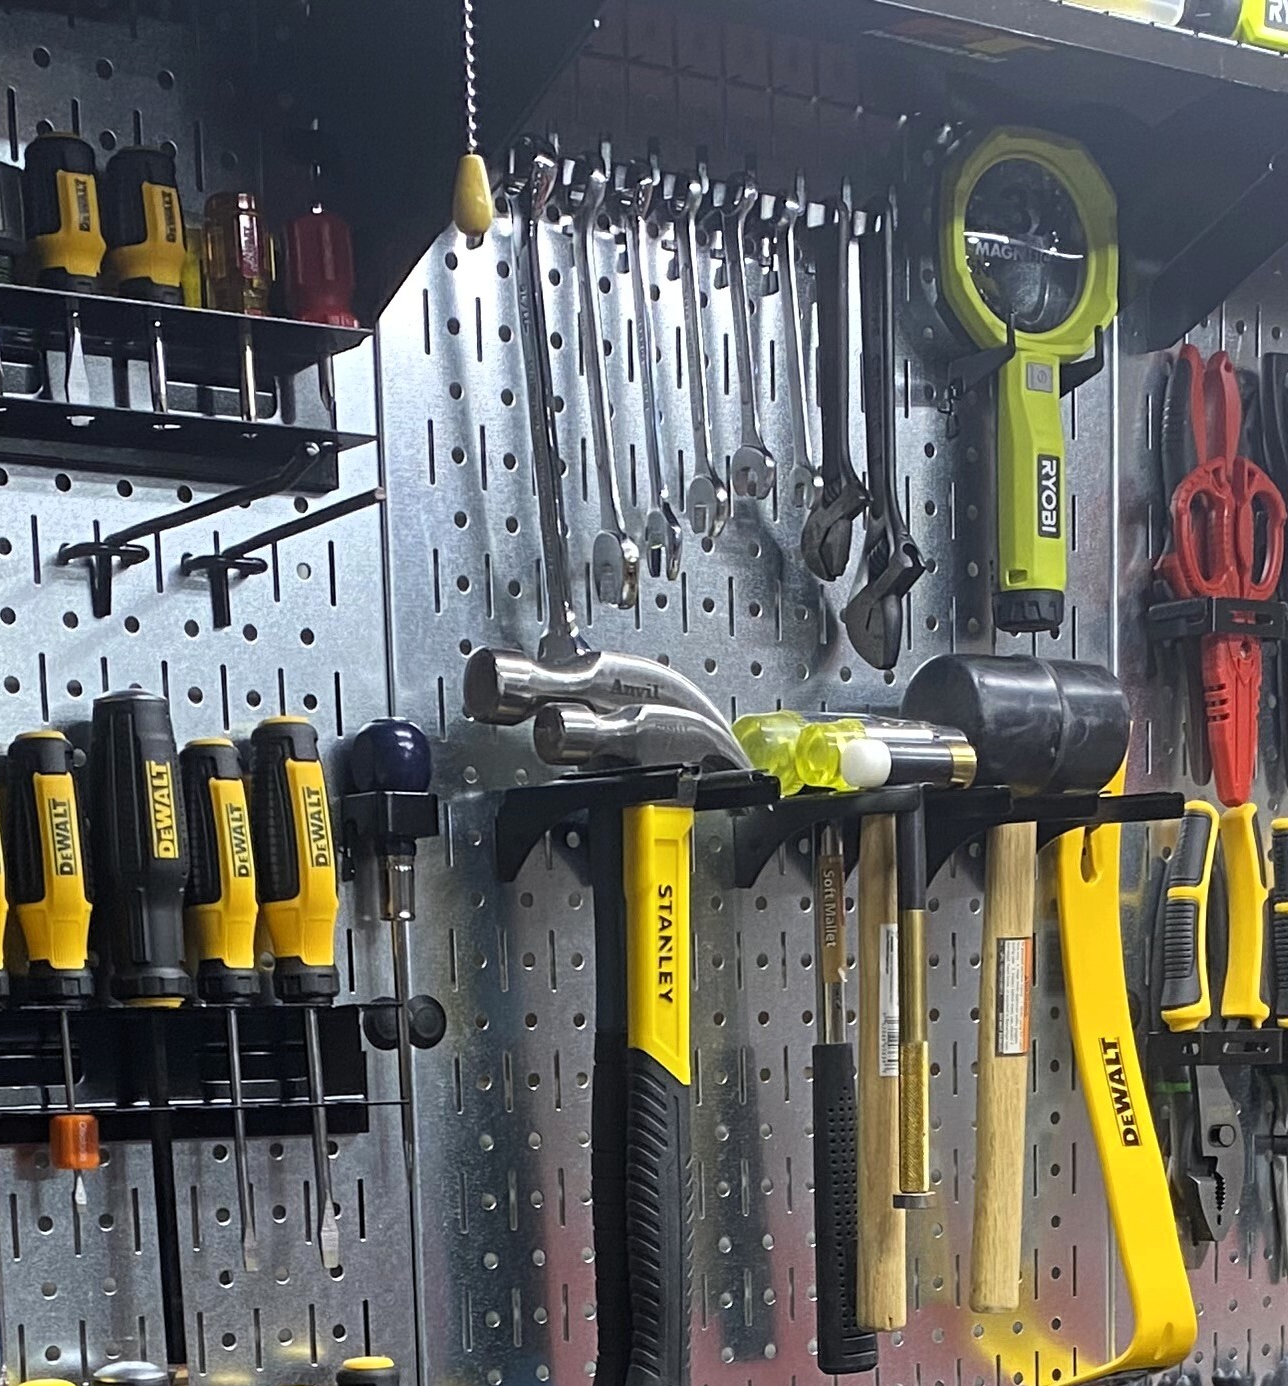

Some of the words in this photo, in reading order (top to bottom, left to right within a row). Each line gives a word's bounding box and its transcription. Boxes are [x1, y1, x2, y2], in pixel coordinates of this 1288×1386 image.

[1040, 460, 1058, 533] RYOBI
[611, 677, 661, 701] Anvil
[55, 798, 75, 876] DEWALT
[146, 761, 179, 858] DEWALT
[230, 803, 252, 877] DEWALT
[306, 786, 331, 867] DEWALT
[823, 870, 838, 902] Soft
[656, 883, 674, 1005] STANLEY
[825, 903, 838, 949] Mallet
[1100, 1037, 1142, 1147] DEWALT
